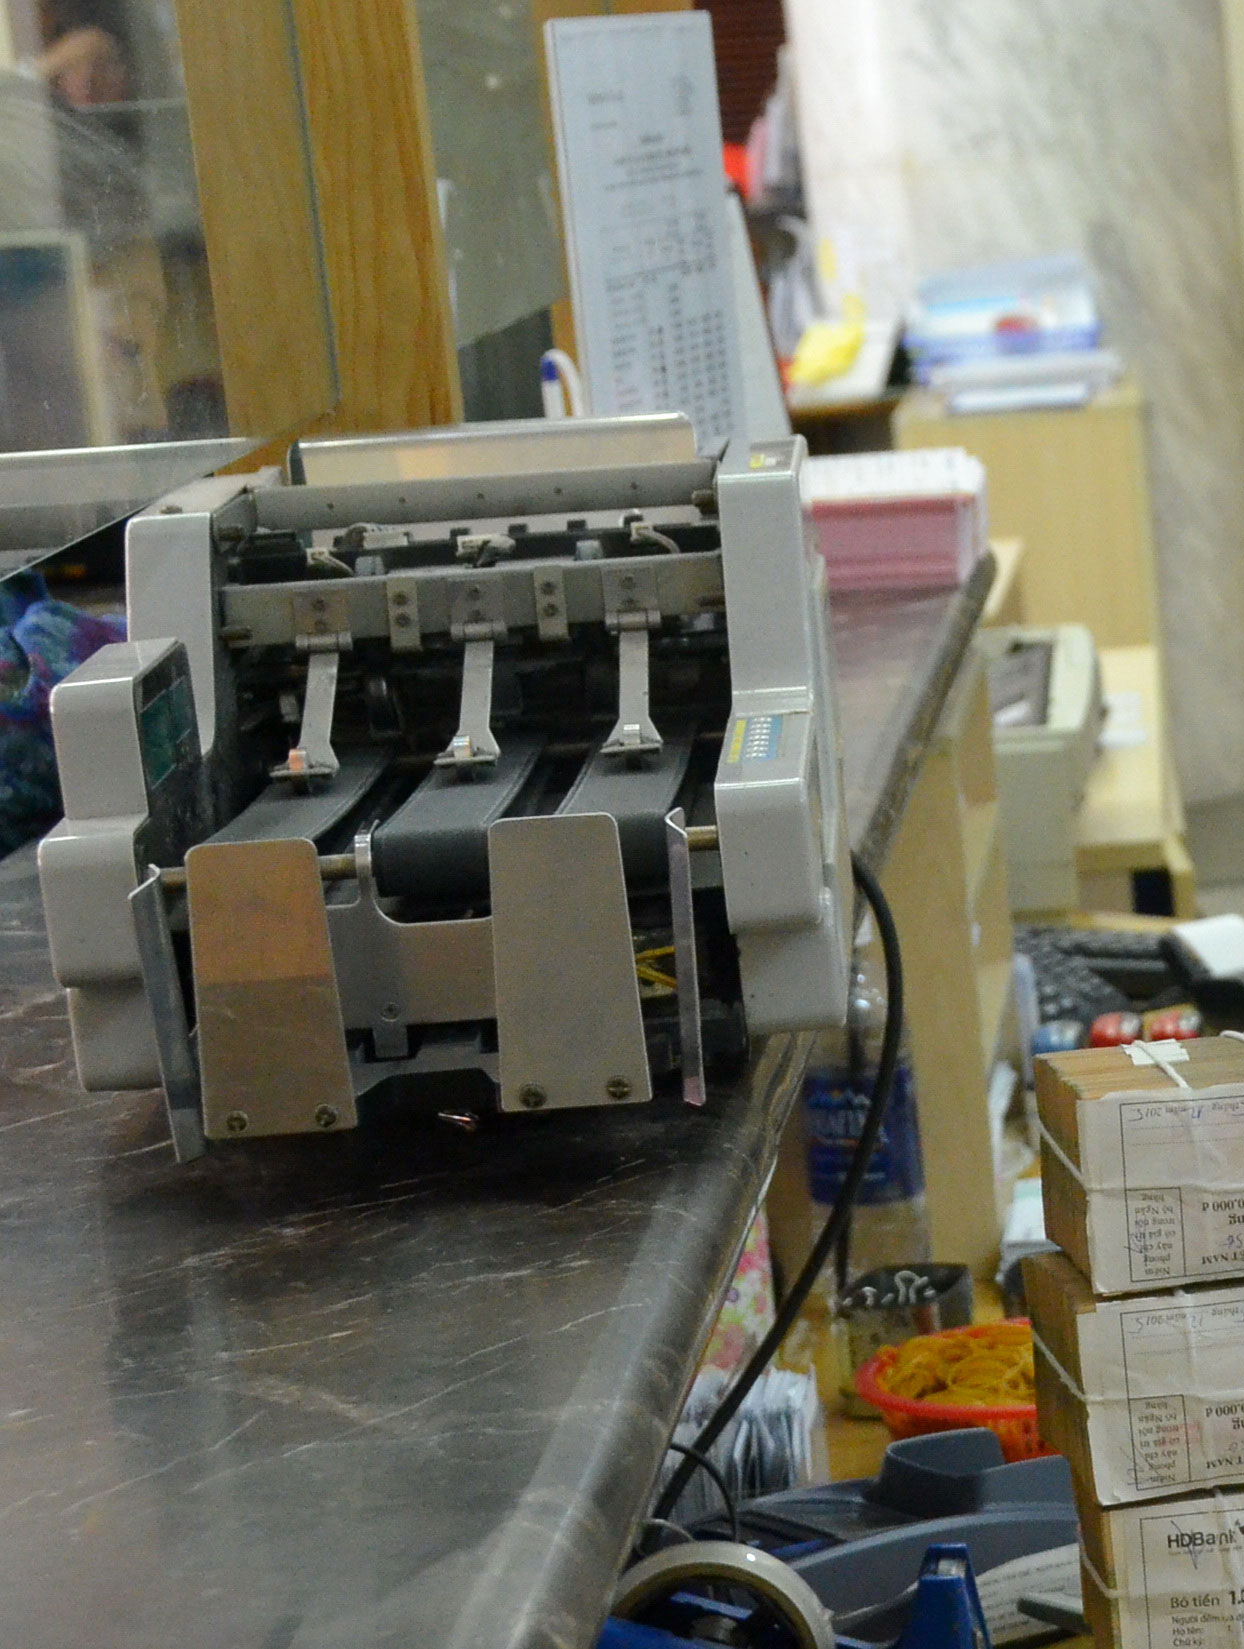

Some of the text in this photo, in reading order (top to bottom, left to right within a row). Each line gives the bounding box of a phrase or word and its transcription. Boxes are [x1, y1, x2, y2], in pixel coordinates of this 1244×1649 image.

[1202, 1254, 1227, 1264] NAM
[1206, 1457, 1233, 1469] NAM
[1168, 1529, 1237, 1548] HDBank
